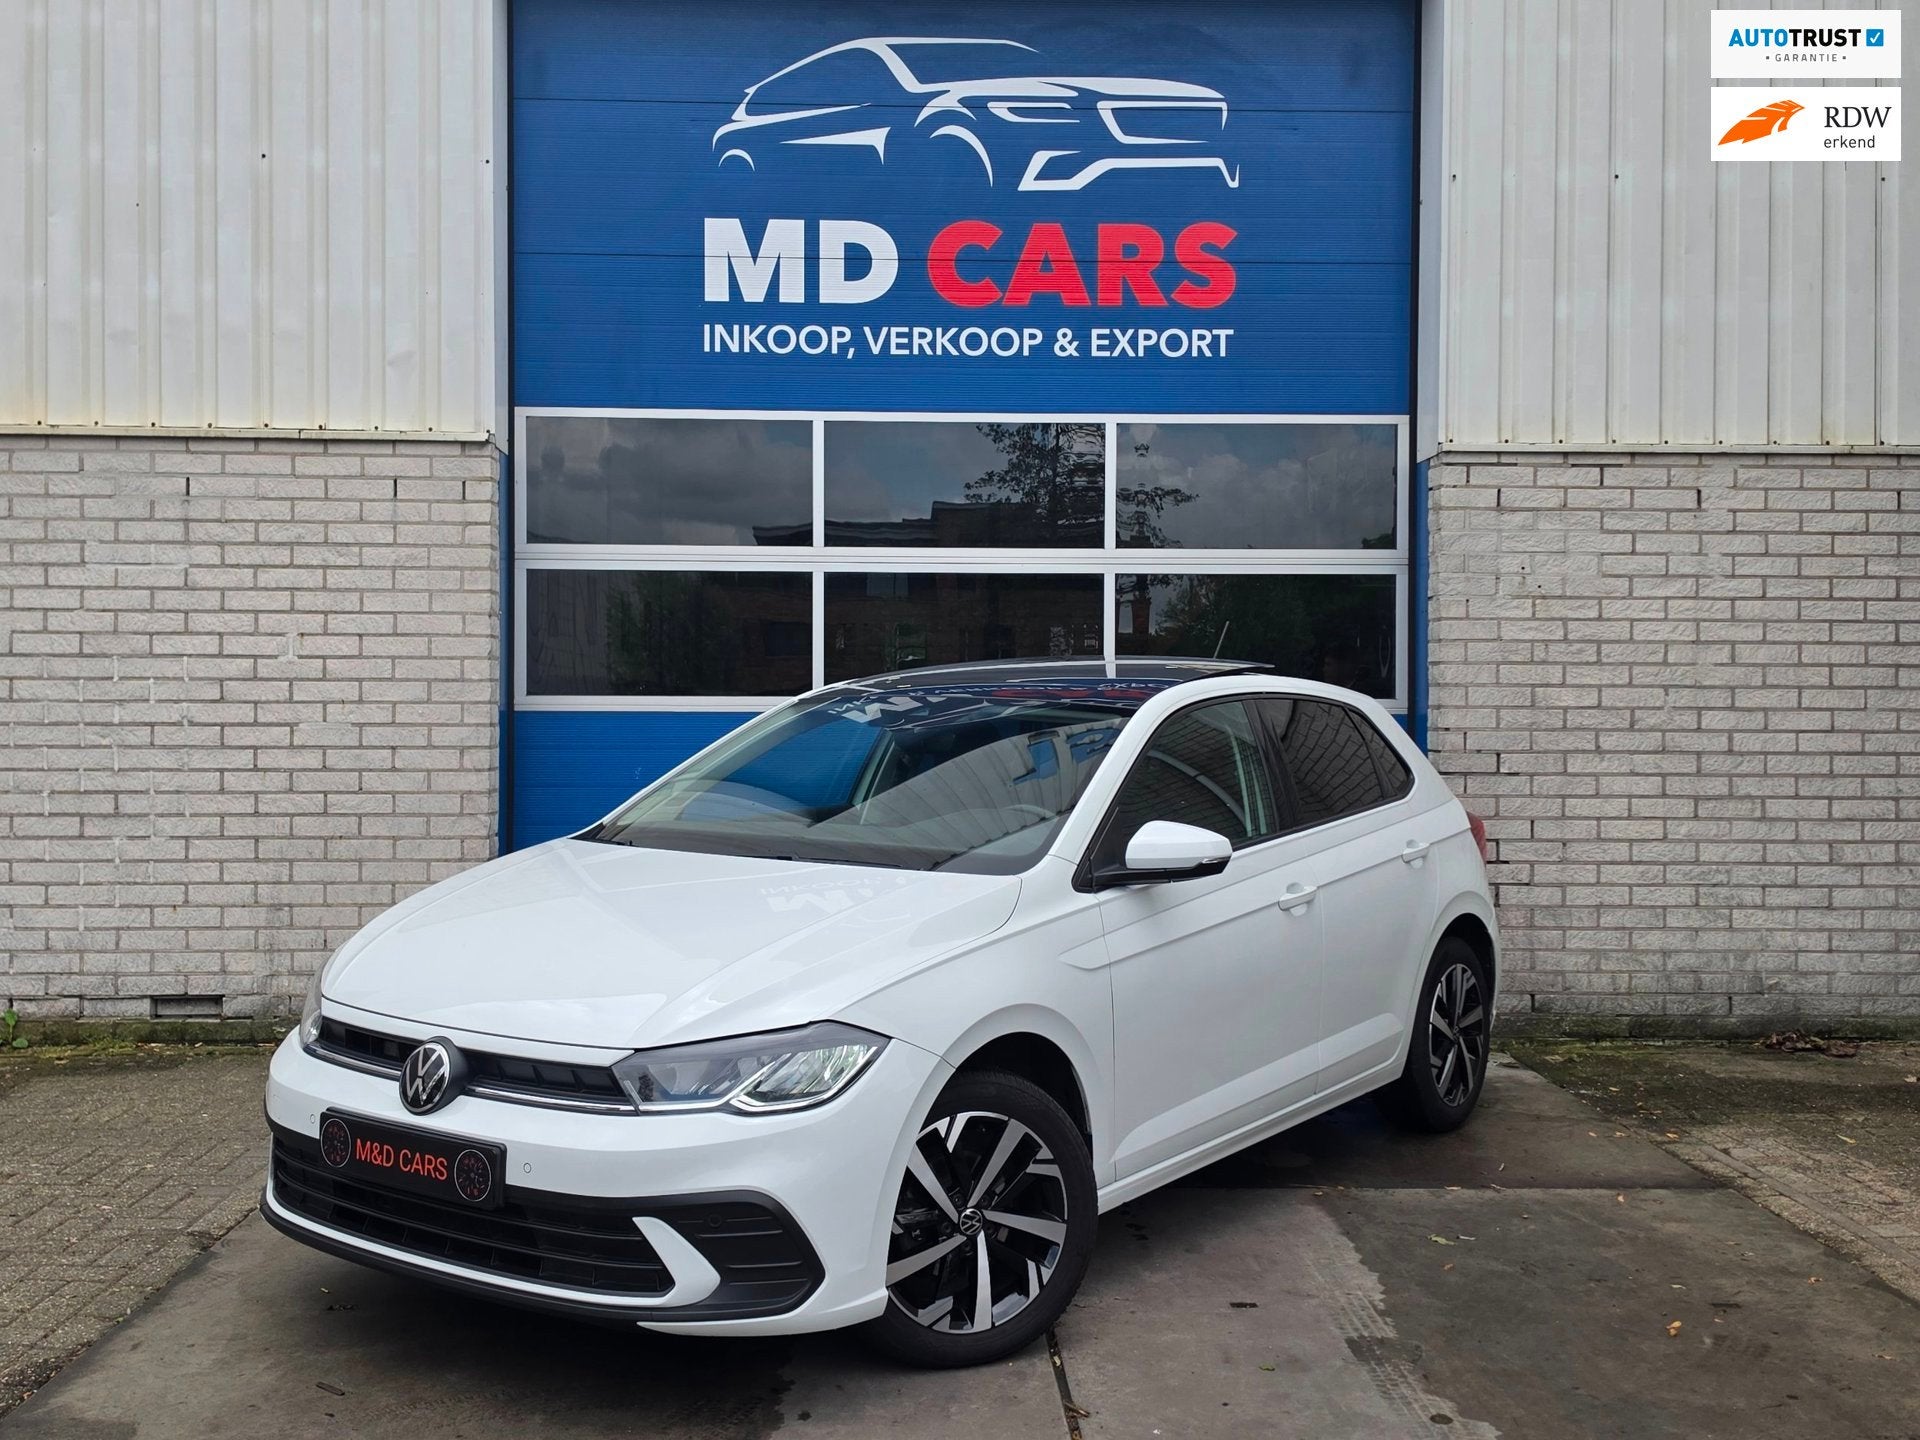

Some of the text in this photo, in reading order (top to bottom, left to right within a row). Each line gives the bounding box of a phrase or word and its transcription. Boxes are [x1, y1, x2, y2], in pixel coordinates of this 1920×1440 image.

[704, 217, 1238, 309] MD CARS
[703, 324, 1234, 359] INKOOP, VERKOOP & EXPORT
[355, 1138, 395, 1168] M&D
[399, 1149, 448, 1181] CARS
